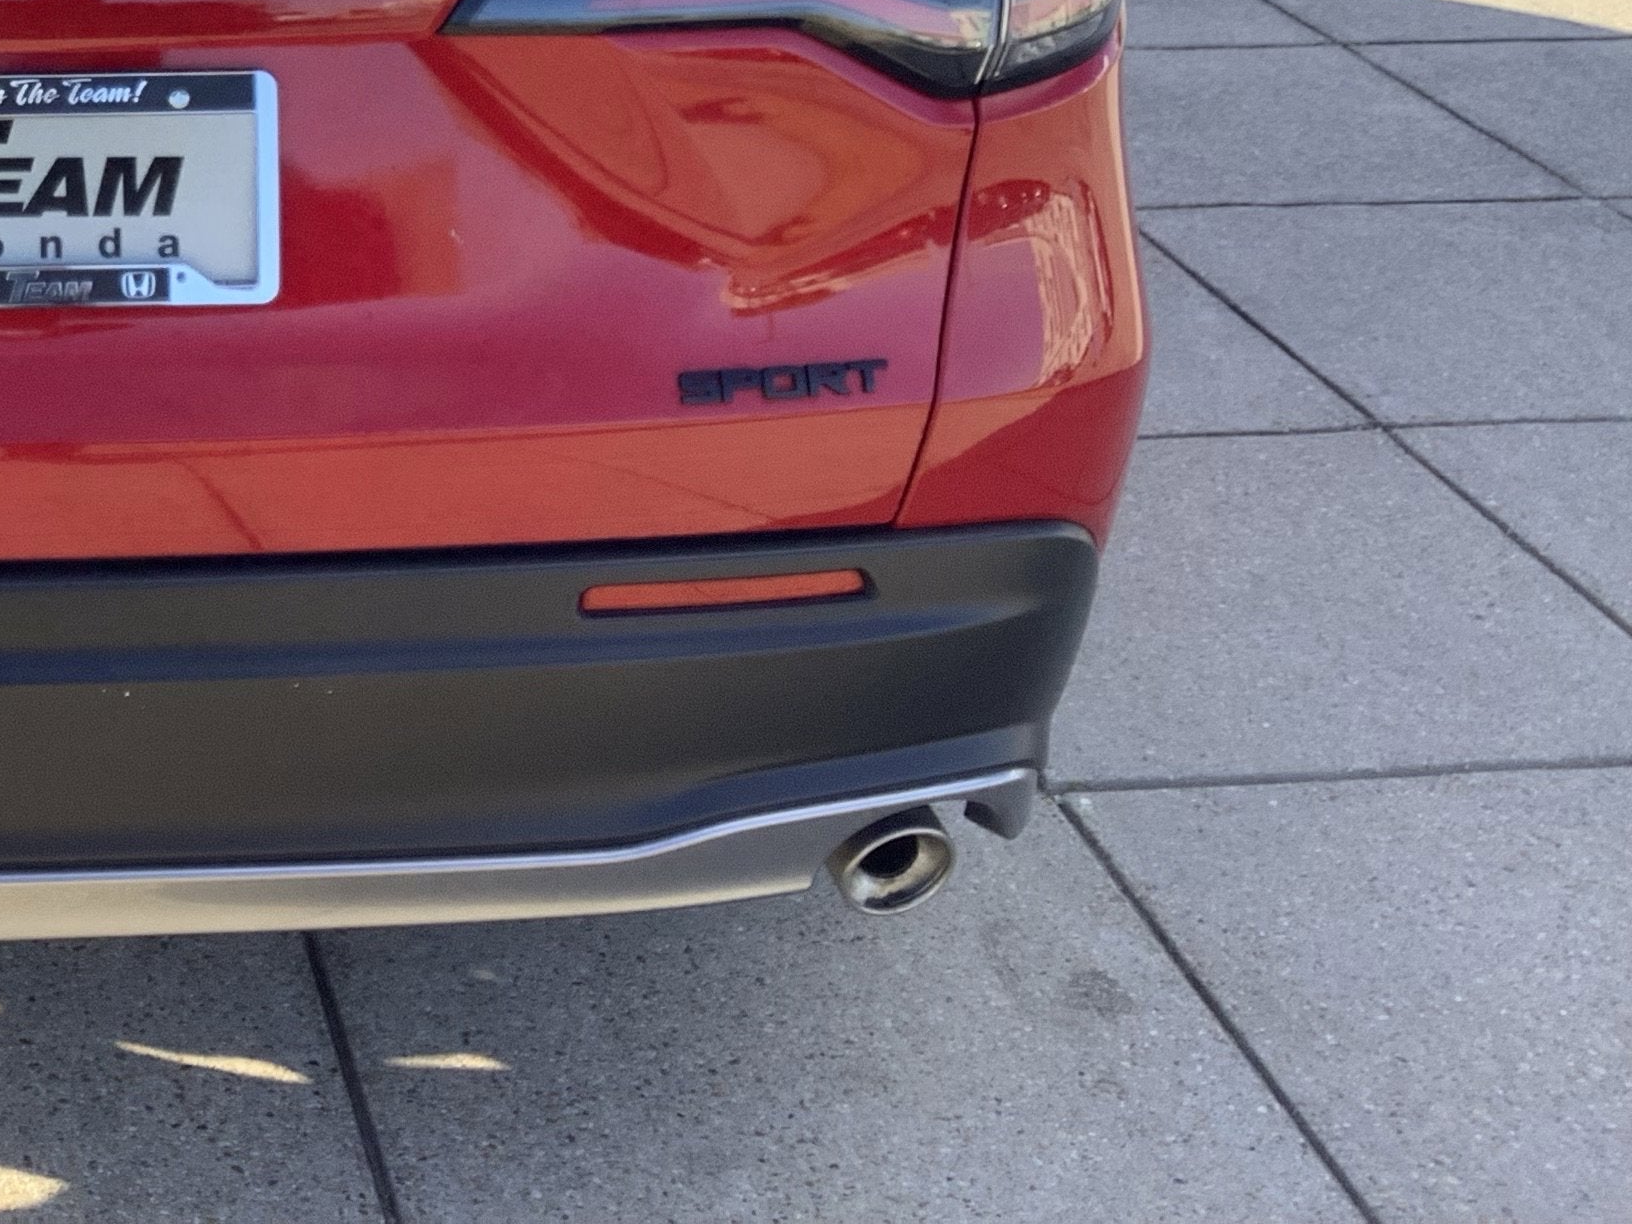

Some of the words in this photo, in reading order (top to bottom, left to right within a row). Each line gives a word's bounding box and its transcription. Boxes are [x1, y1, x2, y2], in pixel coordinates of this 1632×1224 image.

[10, 78, 60, 107] The
[62, 77, 148, 107] Team!
[5, 270, 94, 304] TEAM
[677, 357, 889, 406] SPORT
